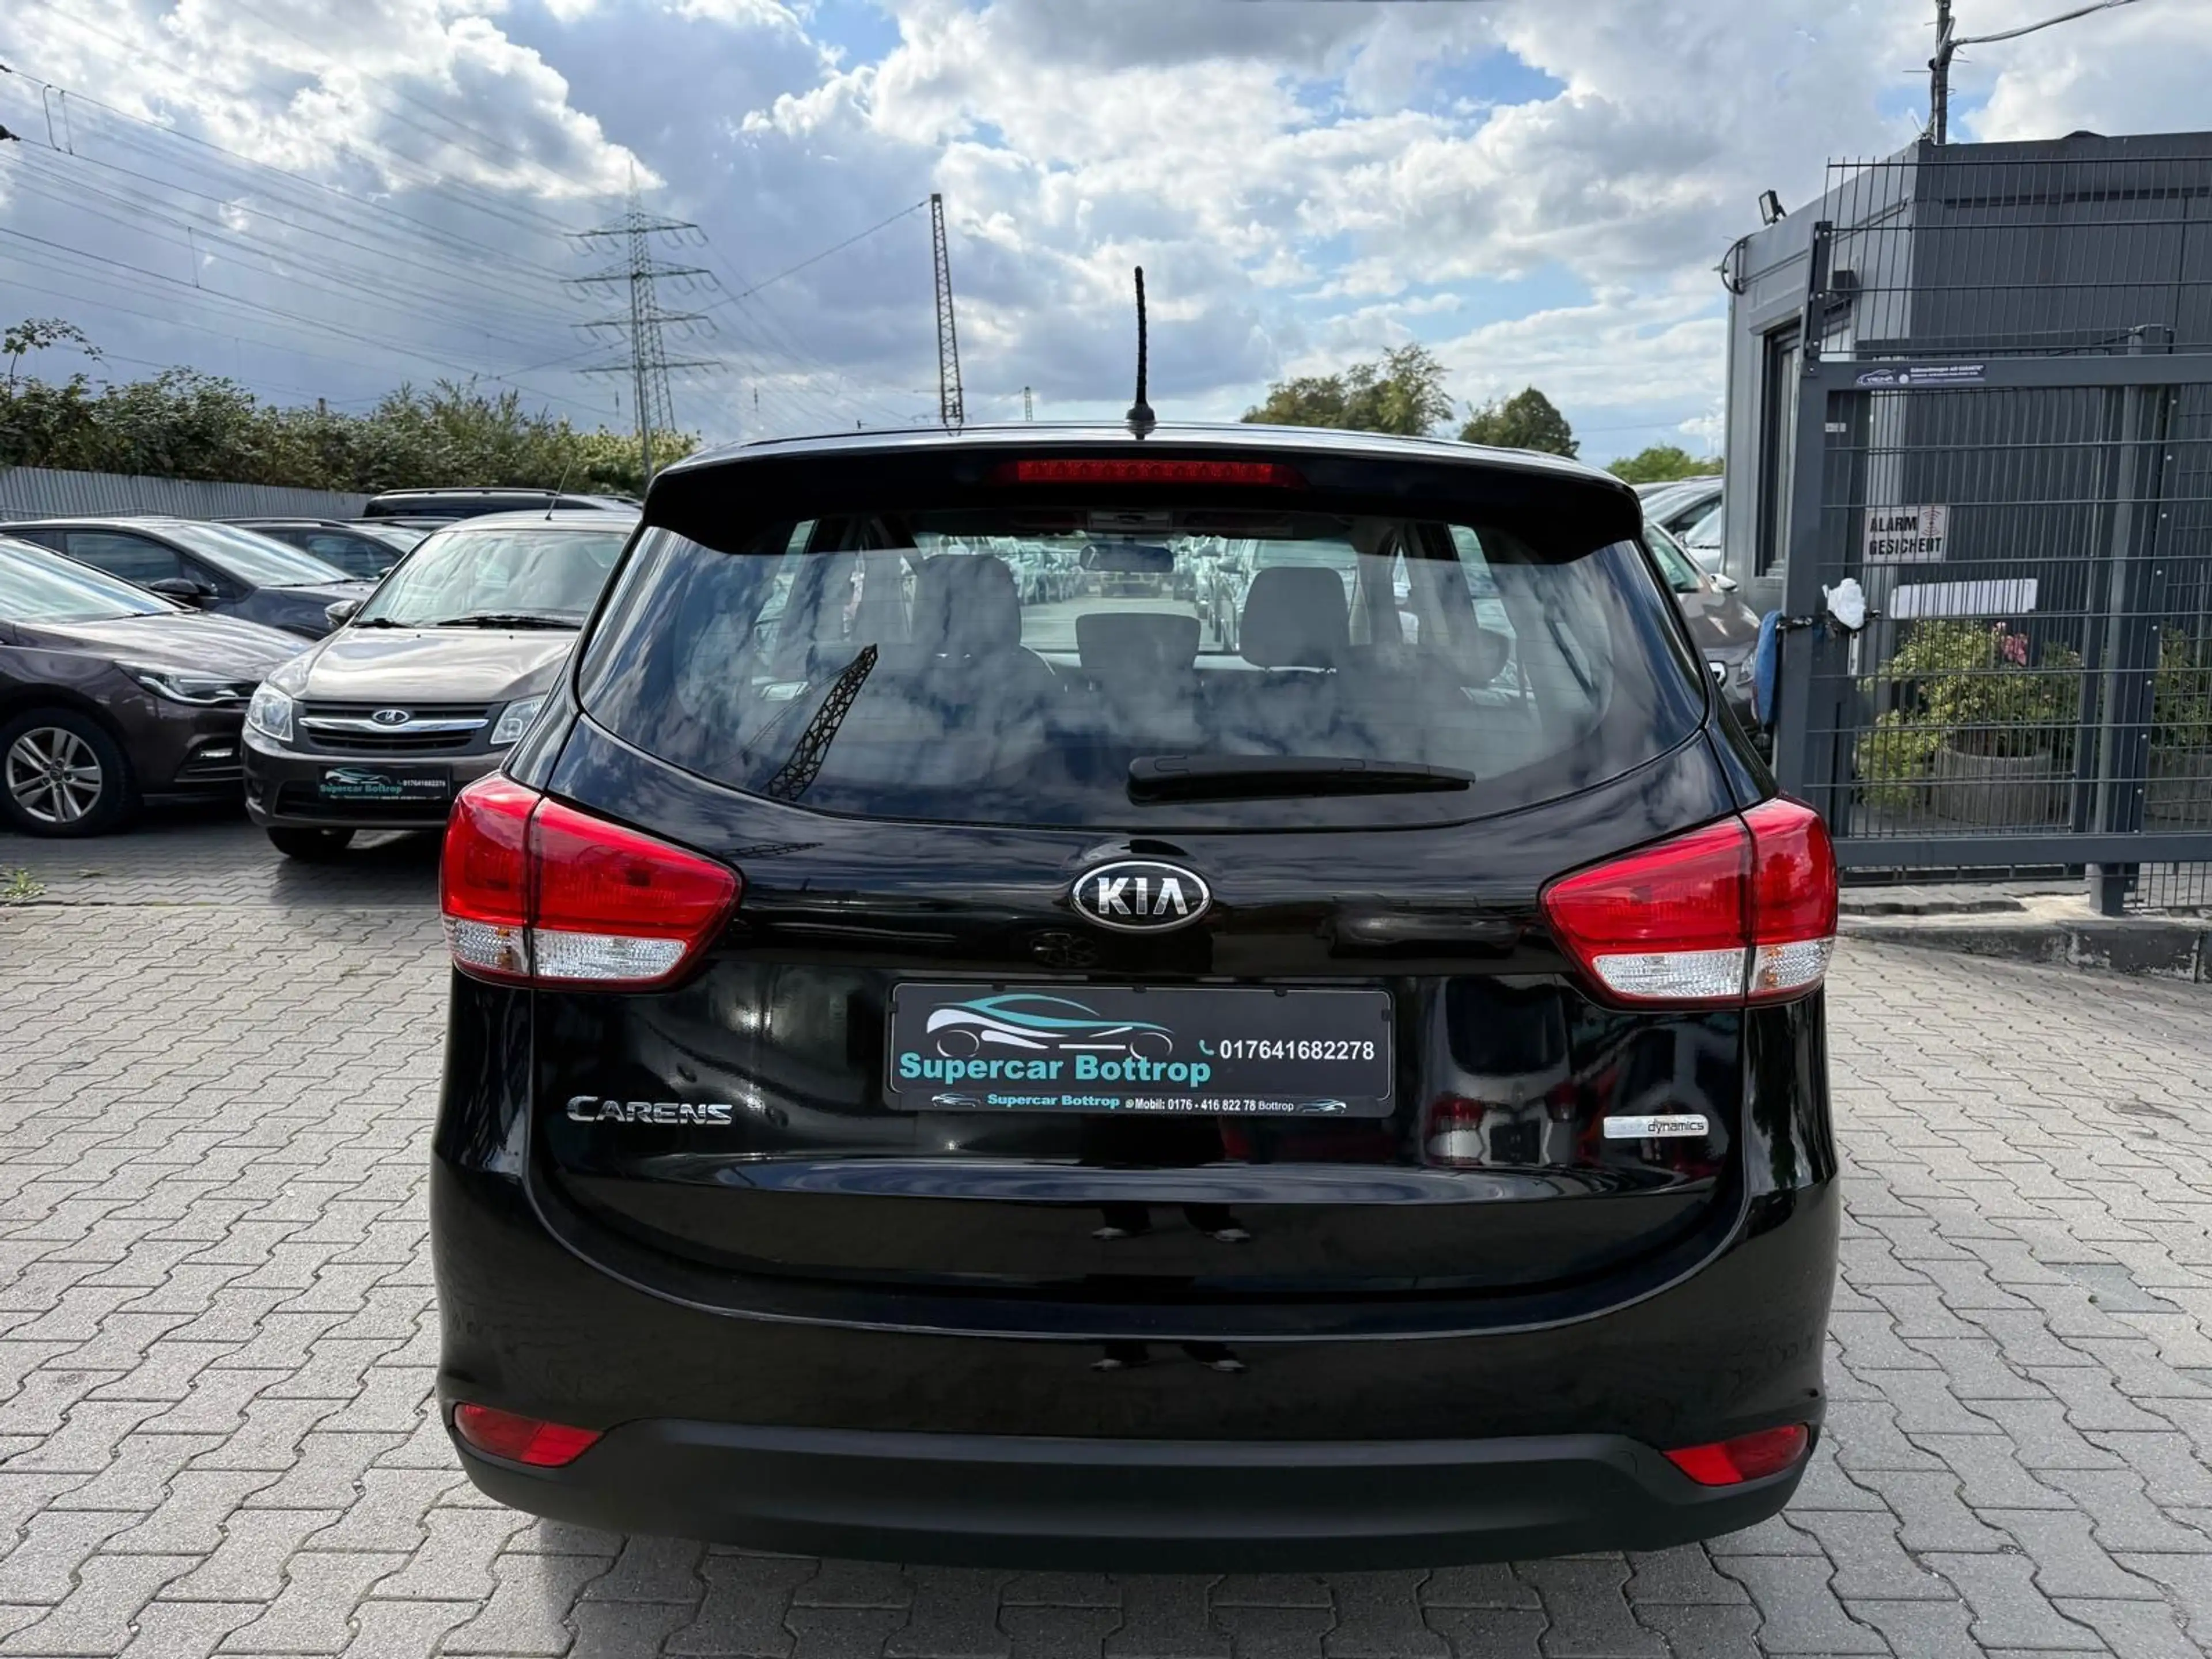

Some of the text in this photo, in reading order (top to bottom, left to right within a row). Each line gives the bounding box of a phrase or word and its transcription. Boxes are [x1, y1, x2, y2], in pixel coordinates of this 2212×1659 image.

[1870, 517, 1917, 532] ALARM
[1097, 877, 1188, 915] KIA
[1219, 1040, 1375, 1060] 017641682278
[899, 1052, 1211, 1087] Supercar Bottrop
[566, 1095, 733, 1125] CARENS
[987, 1094, 1057, 1107] Supercar
[1062, 1095, 1120, 1109] Bottrop
[1168, 1099, 1192, 1111] 0176
[1200, 1100, 1220, 1111] 416
[1222, 1100, 1241, 1111] 822
[1243, 1100, 1256, 1111] 78
[1258, 1101, 1294, 1112] Bottrop
[1647, 1119, 1705, 1134] dynamics
